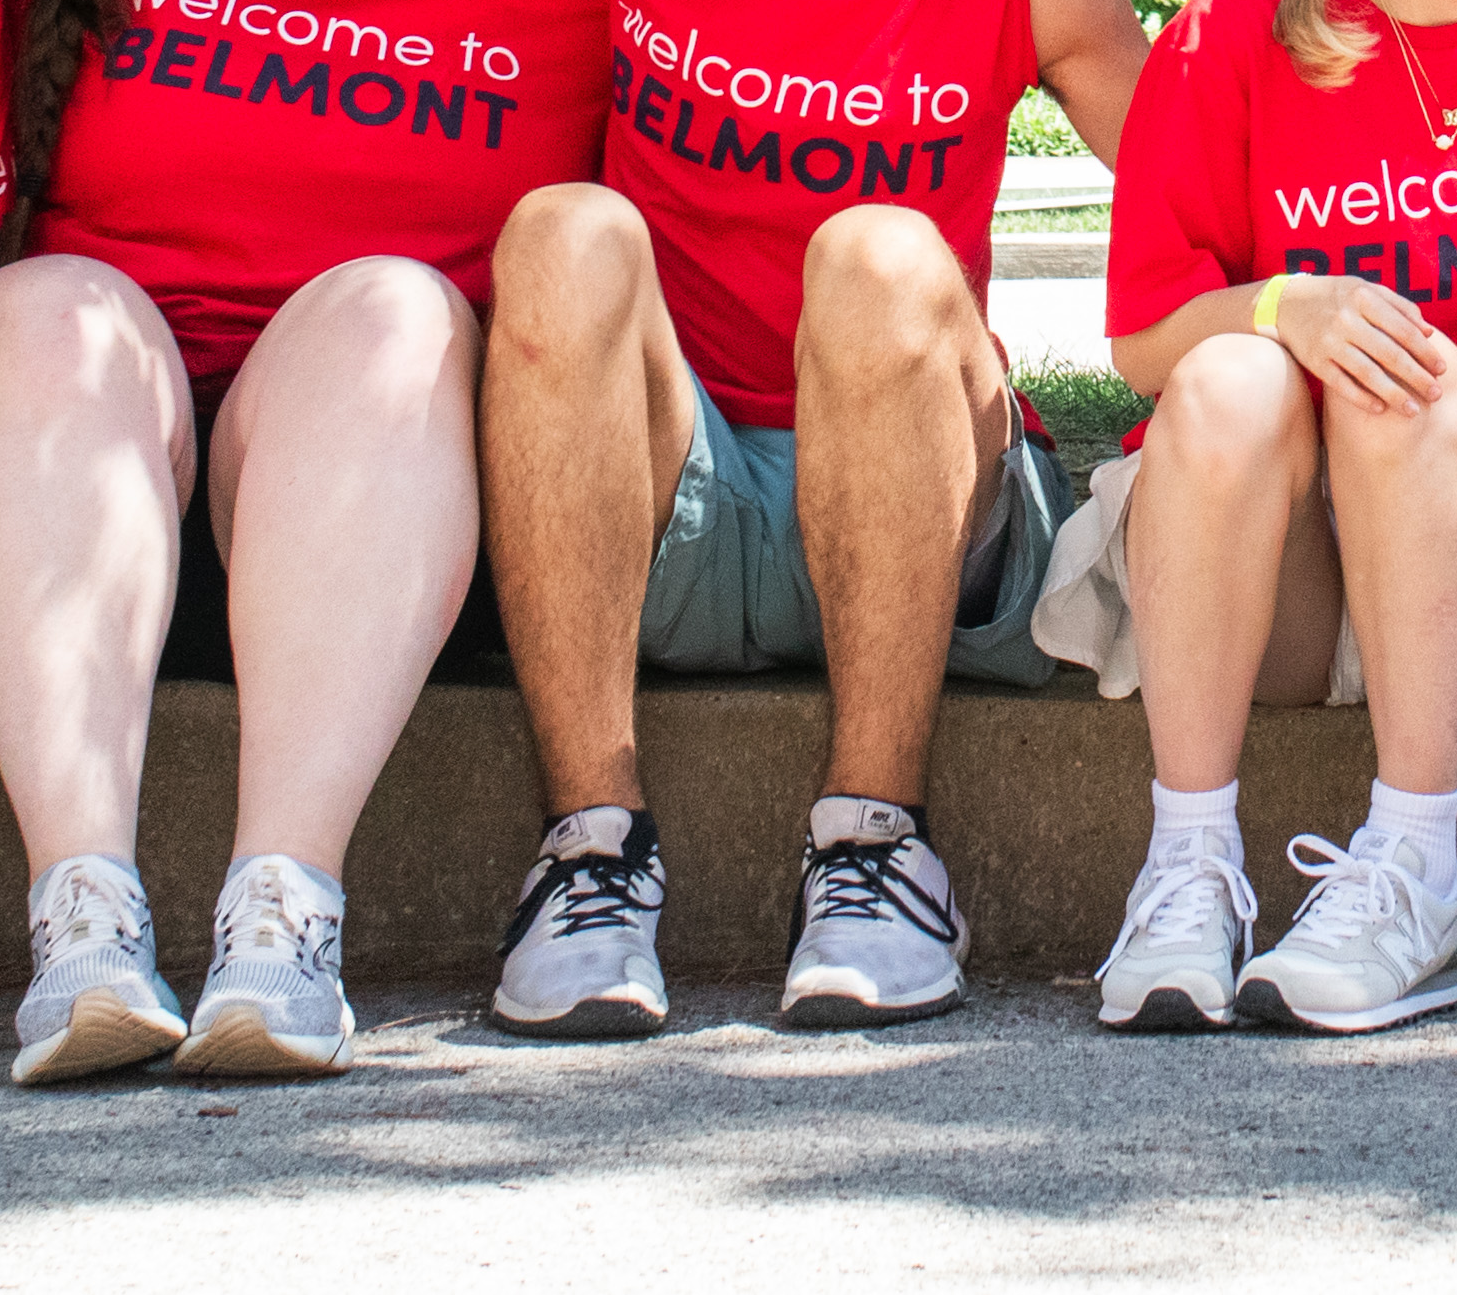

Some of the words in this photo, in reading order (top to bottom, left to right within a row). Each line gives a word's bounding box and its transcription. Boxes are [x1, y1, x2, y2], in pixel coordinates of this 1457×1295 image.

[103, 26, 517, 151] BELMONT
[460, 31, 520, 83] to
[618, 0, 884, 128] welcome
[906, 72, 970, 127] to
[613, 45, 963, 197] BELMONT
